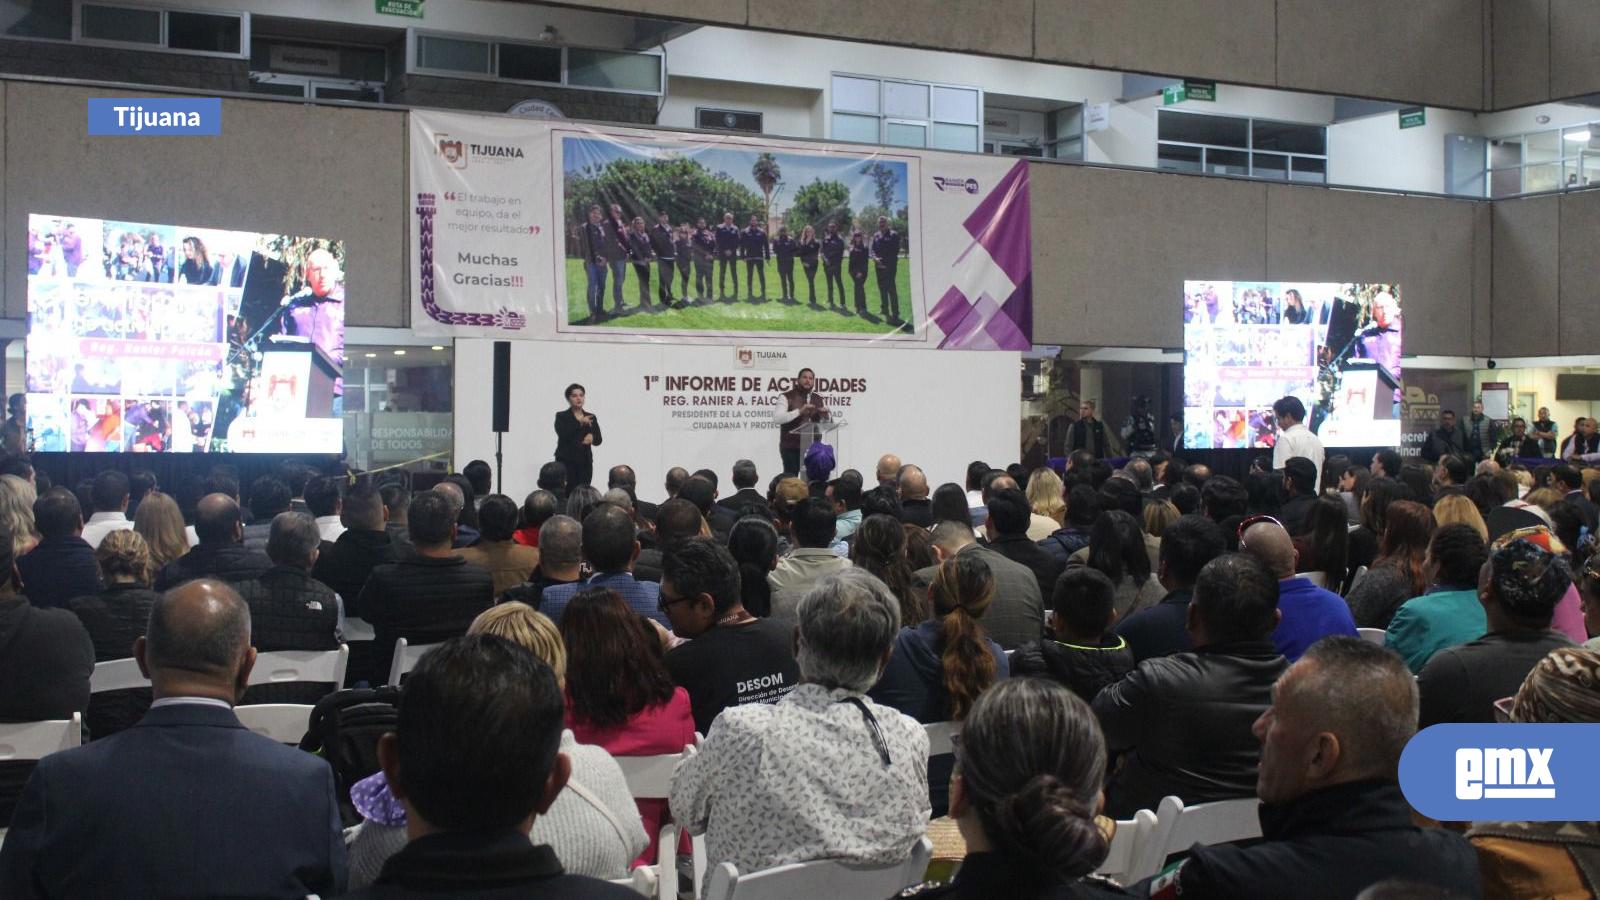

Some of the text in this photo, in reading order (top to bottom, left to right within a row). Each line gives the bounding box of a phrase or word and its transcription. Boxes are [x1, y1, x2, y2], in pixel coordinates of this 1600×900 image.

[470, 144, 525, 159] TIJUANA
[469, 193, 506, 206] trabajo
[495, 210, 510, 219] da
[511, 211, 521, 219] el
[447, 222, 479, 233] mejor
[457, 252, 519, 267] Muchas
[452, 272, 524, 288] Gracias!!!
[756, 351, 787, 359] TIJUANA
[665, 375, 736, 392] INFORME
[741, 376, 762, 392] DE
[767, 376, 867, 393] ACTIDADES
[663, 395, 690, 406] REG.
[692, 395, 734, 406] RANIER
[736, 395, 749, 406] A.
[751, 395, 777, 406] FALC
[671, 410, 774, 418] PRESIDENTE DE LA COMISI
[692, 421, 780, 430] CIUDADANA Y PROTEC
[371, 440, 423, 450] DE TODOS
[736, 672, 784, 694] DESOM
[738, 691, 768, 702] Dirección
